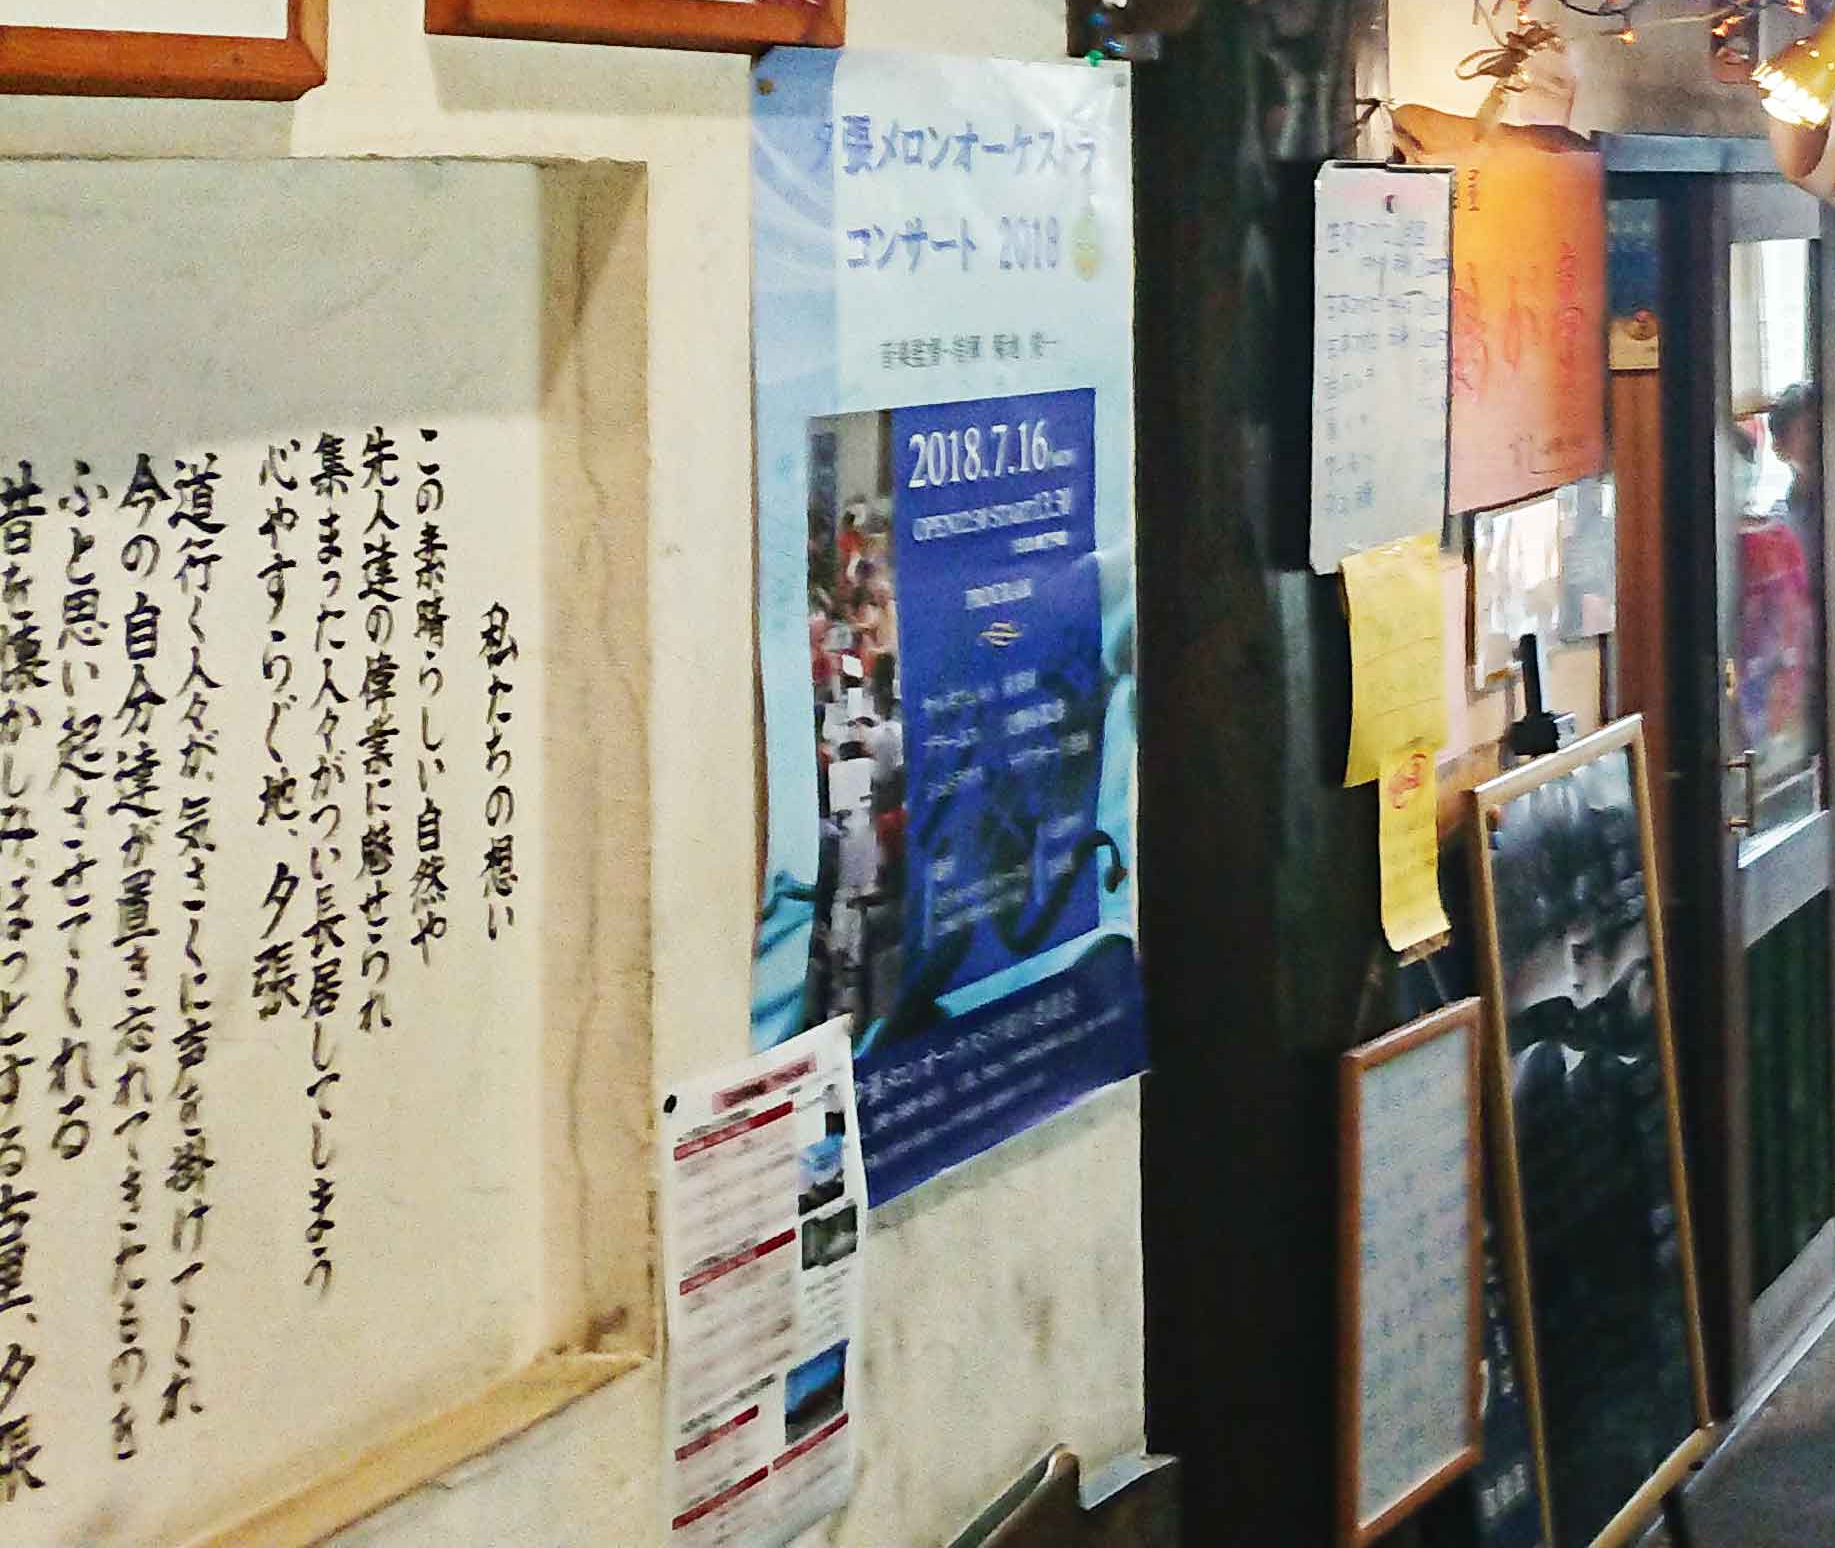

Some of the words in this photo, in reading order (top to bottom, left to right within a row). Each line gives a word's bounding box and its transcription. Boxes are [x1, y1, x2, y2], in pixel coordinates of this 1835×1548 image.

[846, 214, 977, 273] コンサート
[907, 418, 1050, 490] 2018.7.16
[409, 427, 449, 967] この素晴らしい自然や
[479, 602, 519, 941] 私たちの想い
